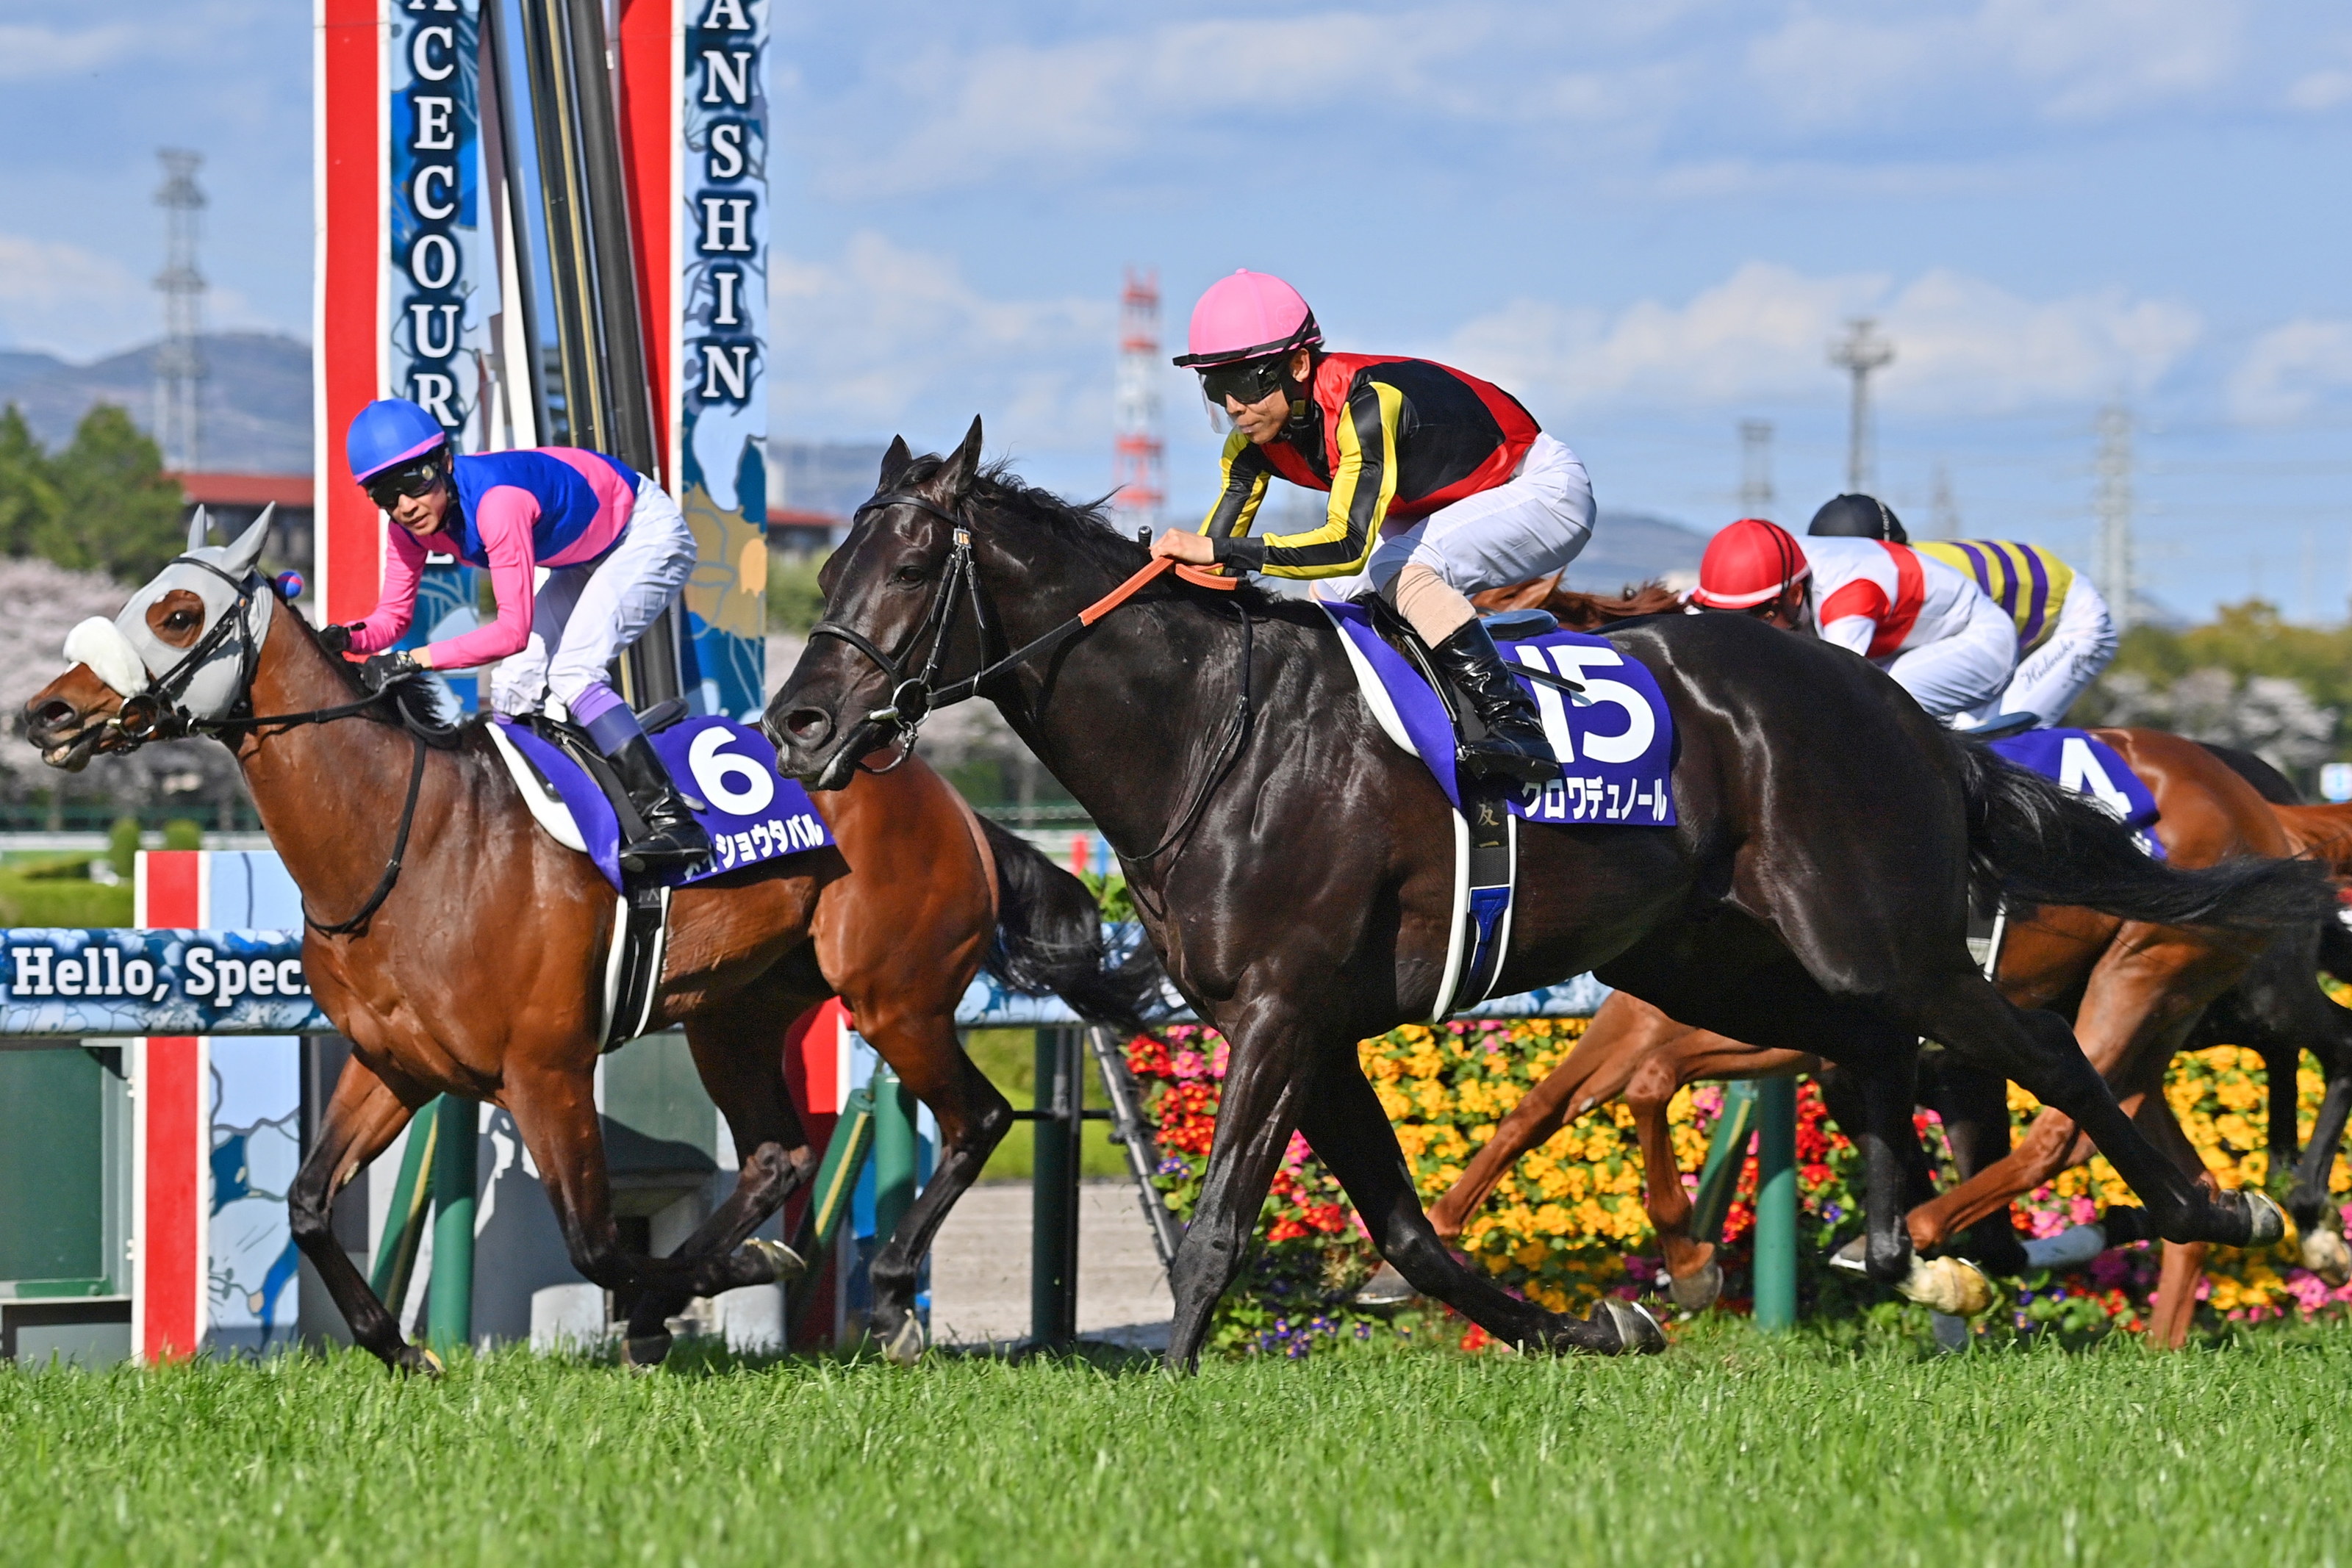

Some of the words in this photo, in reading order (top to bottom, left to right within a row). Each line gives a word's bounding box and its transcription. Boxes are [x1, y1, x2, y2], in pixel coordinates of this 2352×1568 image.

[408, 0, 459, 564] CECOUR
[958, 532, 969, 545] 15
[1514, 644, 1656, 764] 15
[688, 725, 775, 816] 6
[1521, 775, 1668, 821] クロワデュノール
[684, 813, 825, 882] ショウタバル
[11, 946, 170, 1002] Hello,
[184, 946, 312, 1008] Spec
